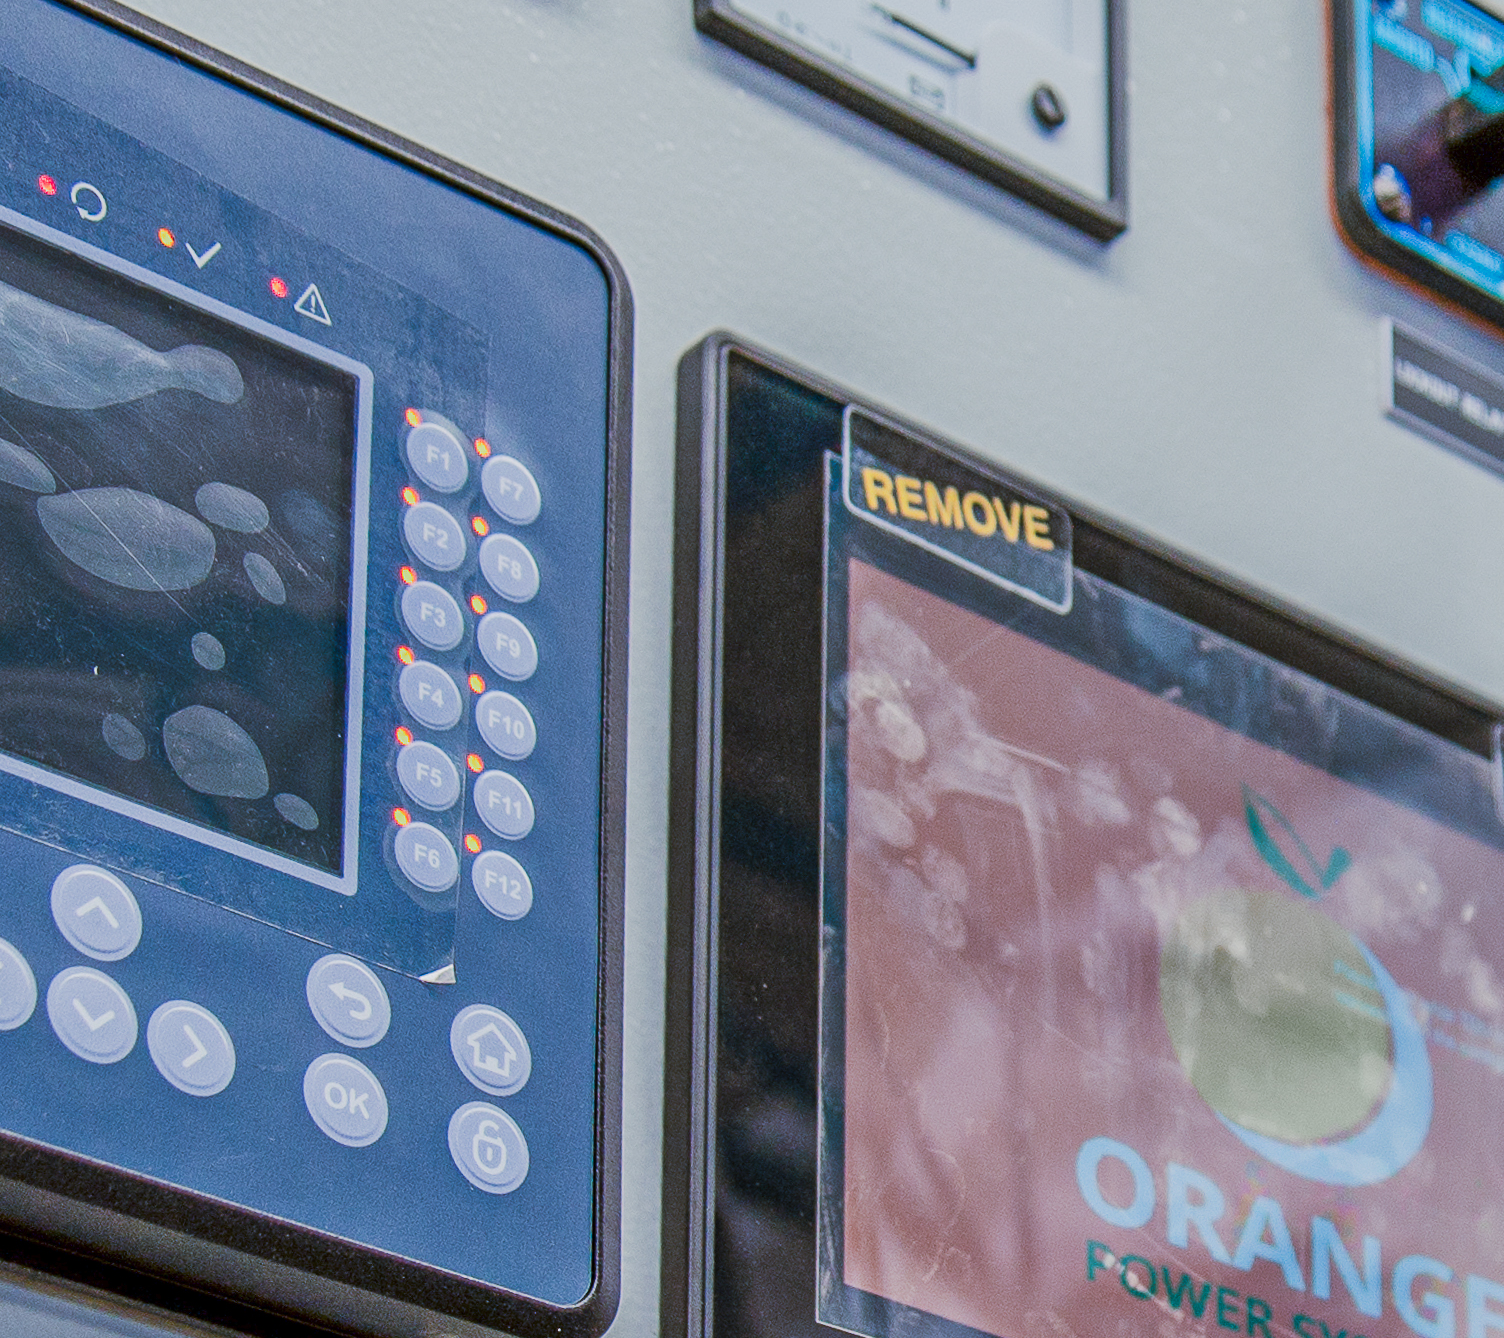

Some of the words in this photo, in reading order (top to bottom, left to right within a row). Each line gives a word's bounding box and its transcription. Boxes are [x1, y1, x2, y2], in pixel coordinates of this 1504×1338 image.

[426, 444, 451, 471] F1
[499, 476, 524, 502] F7
[861, 466, 1055, 552] REMOVE
[422, 522, 448, 549] F2
[497, 554, 522, 581] F8
[420, 601, 446, 628] F3
[496, 632, 521, 659] F9
[418, 681, 445, 708] F4
[488, 708, 525, 740] F10
[415, 761, 442, 788] F5
[488, 789, 522, 820] F11
[414, 842, 441, 869] F6
[485, 869, 522, 901] F12
[324, 1082, 370, 1120] OK
